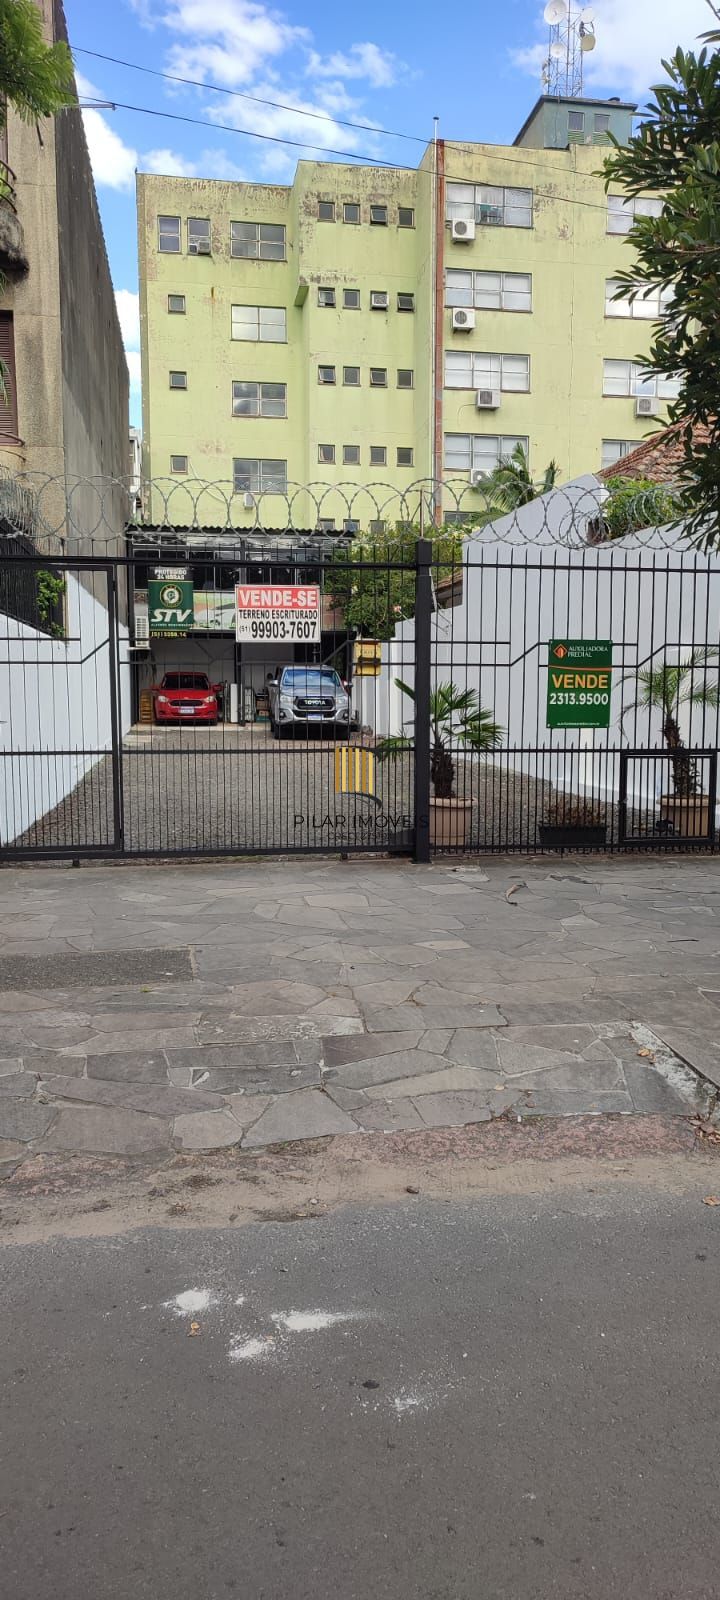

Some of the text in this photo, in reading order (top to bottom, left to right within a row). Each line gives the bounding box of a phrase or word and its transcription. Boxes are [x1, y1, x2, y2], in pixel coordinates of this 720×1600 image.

[239, 589, 317, 607] VENDE-SE
[150, 608, 192, 622] STV
[239, 609, 318, 620] TERRENO ESCRITURADO
[251, 620, 317, 639] 99903-7607
[551, 674, 609, 689] VENDE
[549, 692, 609, 705] 2313.9500
